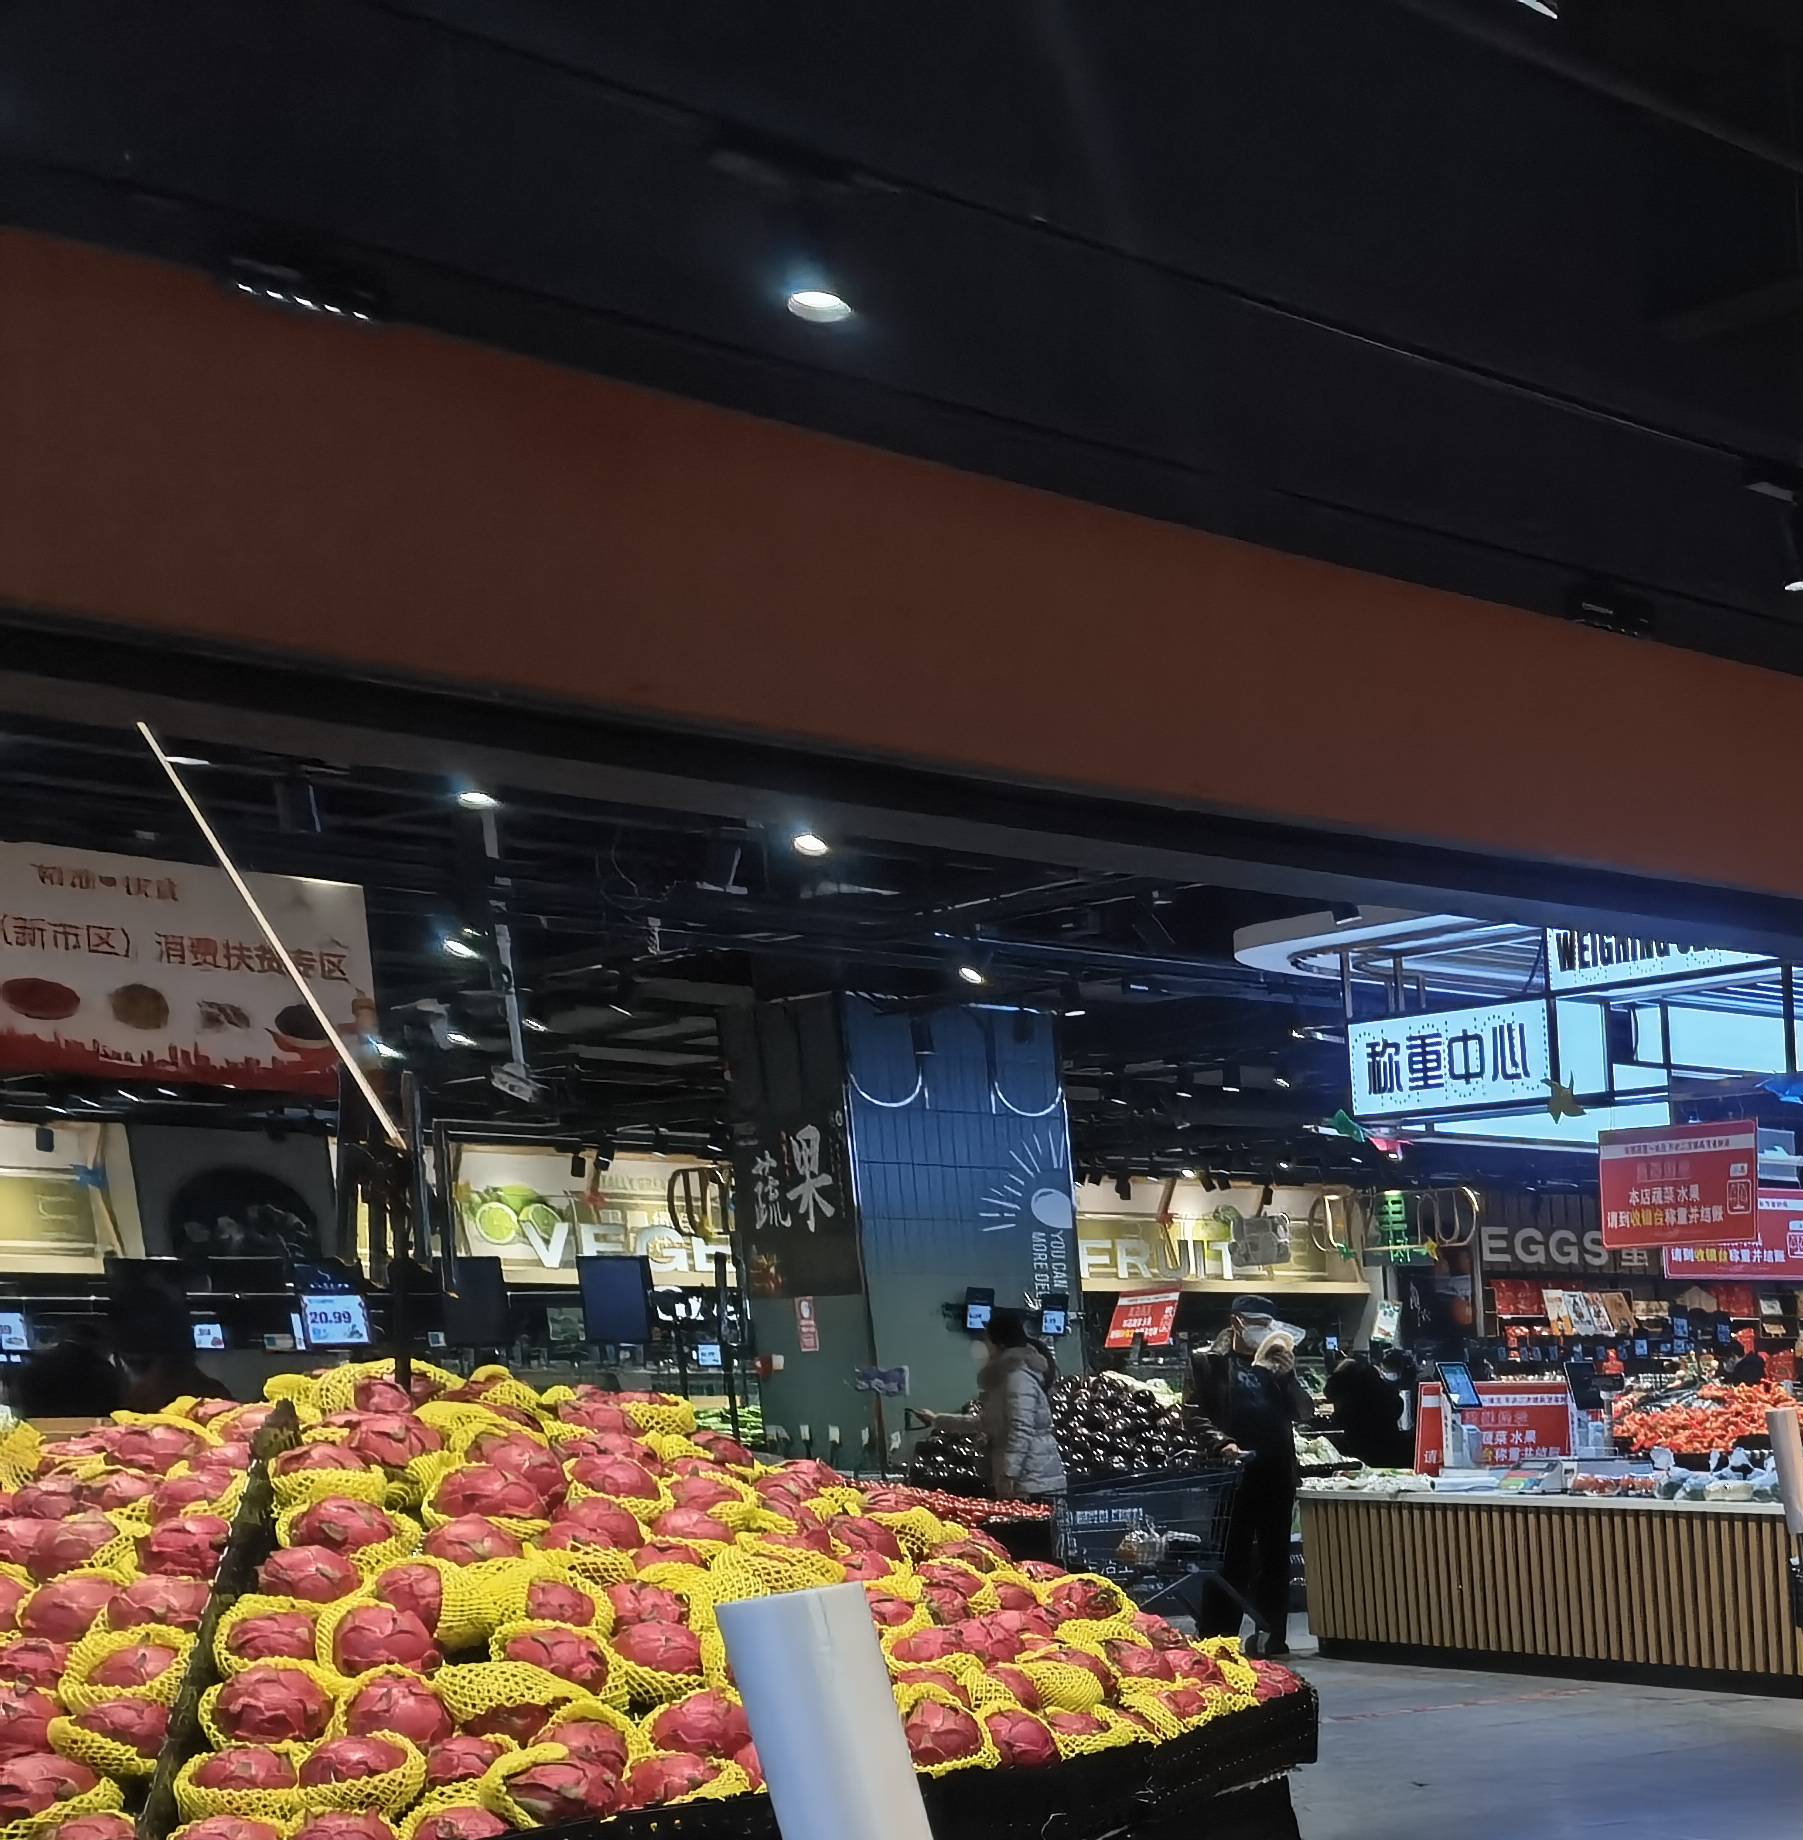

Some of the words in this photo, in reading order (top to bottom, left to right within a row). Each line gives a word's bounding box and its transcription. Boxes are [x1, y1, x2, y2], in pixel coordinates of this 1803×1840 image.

[1366, 1023, 1530, 1095] 称重中心
[1628, 1183, 1700, 1207] 本店蔬菜水果
[1607, 1204, 1724, 1230] 请到收银台称重并结账
[1032, 1231, 1049, 1271] MORE
[1481, 1226, 1609, 1266] EGGS
[309, 1310, 352, 1325] 20.99
